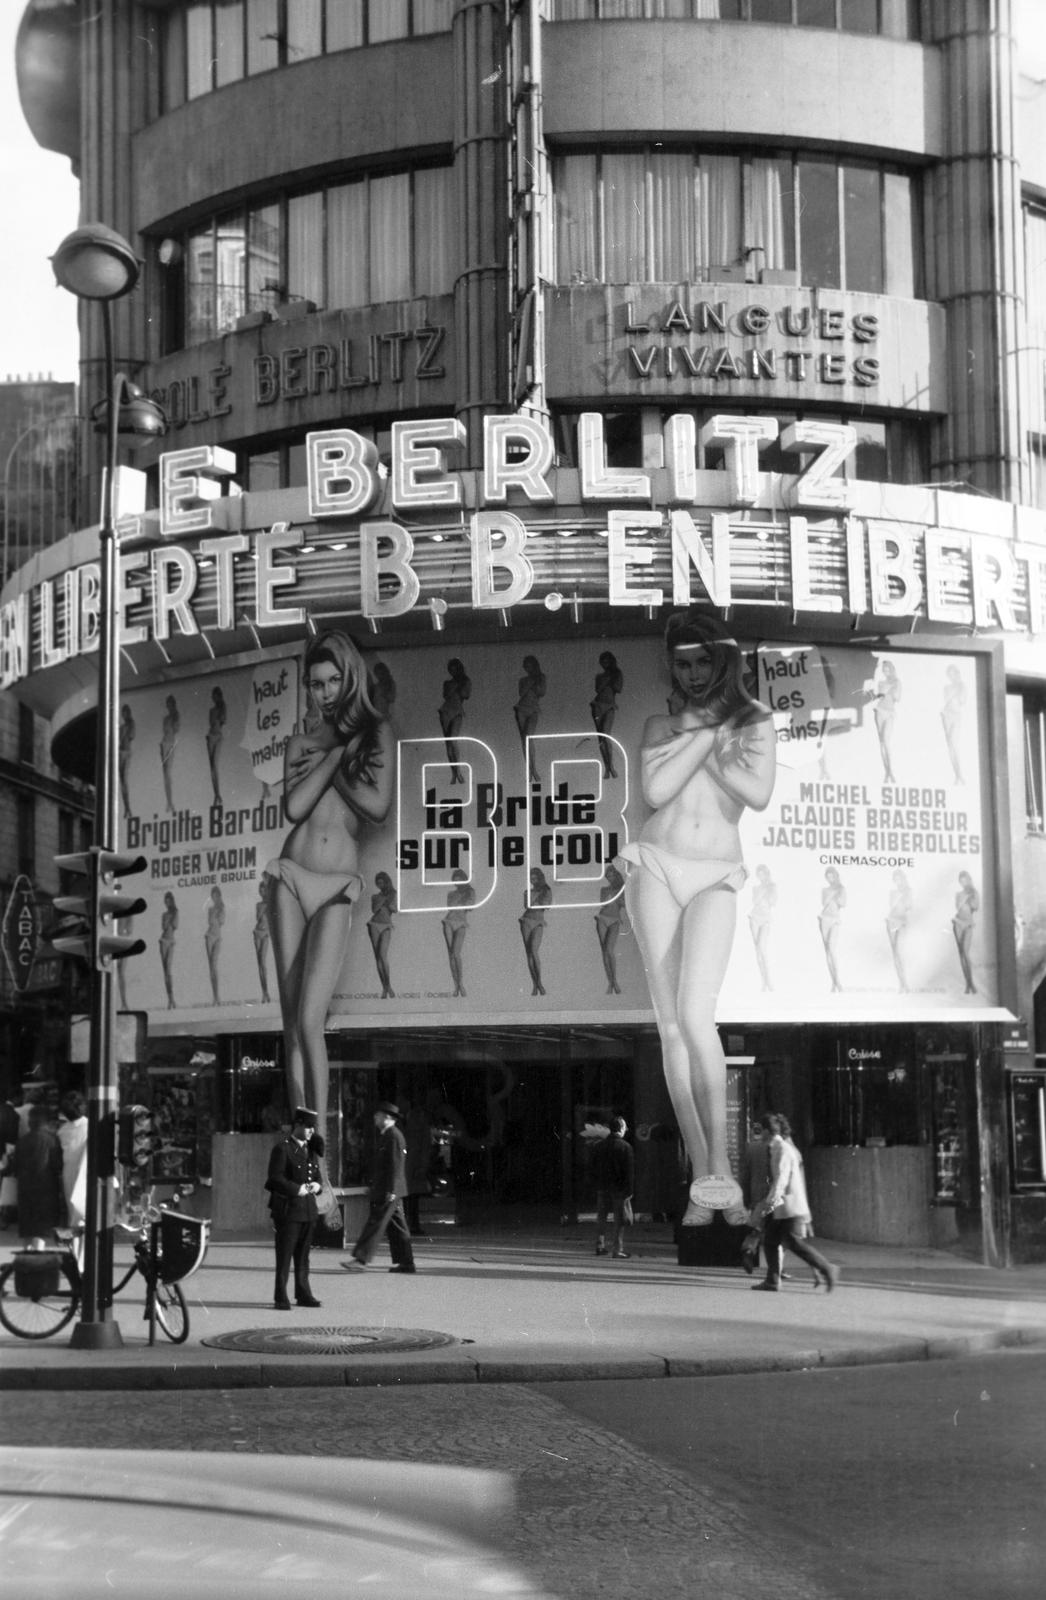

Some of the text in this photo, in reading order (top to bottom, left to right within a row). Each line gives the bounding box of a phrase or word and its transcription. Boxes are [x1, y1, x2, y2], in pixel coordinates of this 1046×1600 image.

[624, 300, 880, 343] LANGUES
[253, 325, 446, 407] BERLITZ
[627, 345, 881, 387] VIVANTES
[306, 411, 858, 518] BERLITZ
[608, 510, 732, 607] EN
[762, 651, 809, 681] haut
[253, 667, 288, 704] haut
[768, 685, 805, 711] les
[257, 708, 280, 731] les
[426, 782, 596, 830] la Bride
[799, 782, 946, 809] MICHEL SUBOR
[127, 808, 203, 853] Brigitte
[780, 804, 968, 832] CLAUDE BRASSEUR
[396, 829, 618, 870] sur le cou
[763, 826, 981, 855] JACQUES RIBEROLLES
[151, 846, 257, 879] ROGER VADIM
[819, 854, 916, 868] CINEMASCOPE
[177, 873, 217, 888] CLAUDE
[18, 889, 33, 967] TABAC
